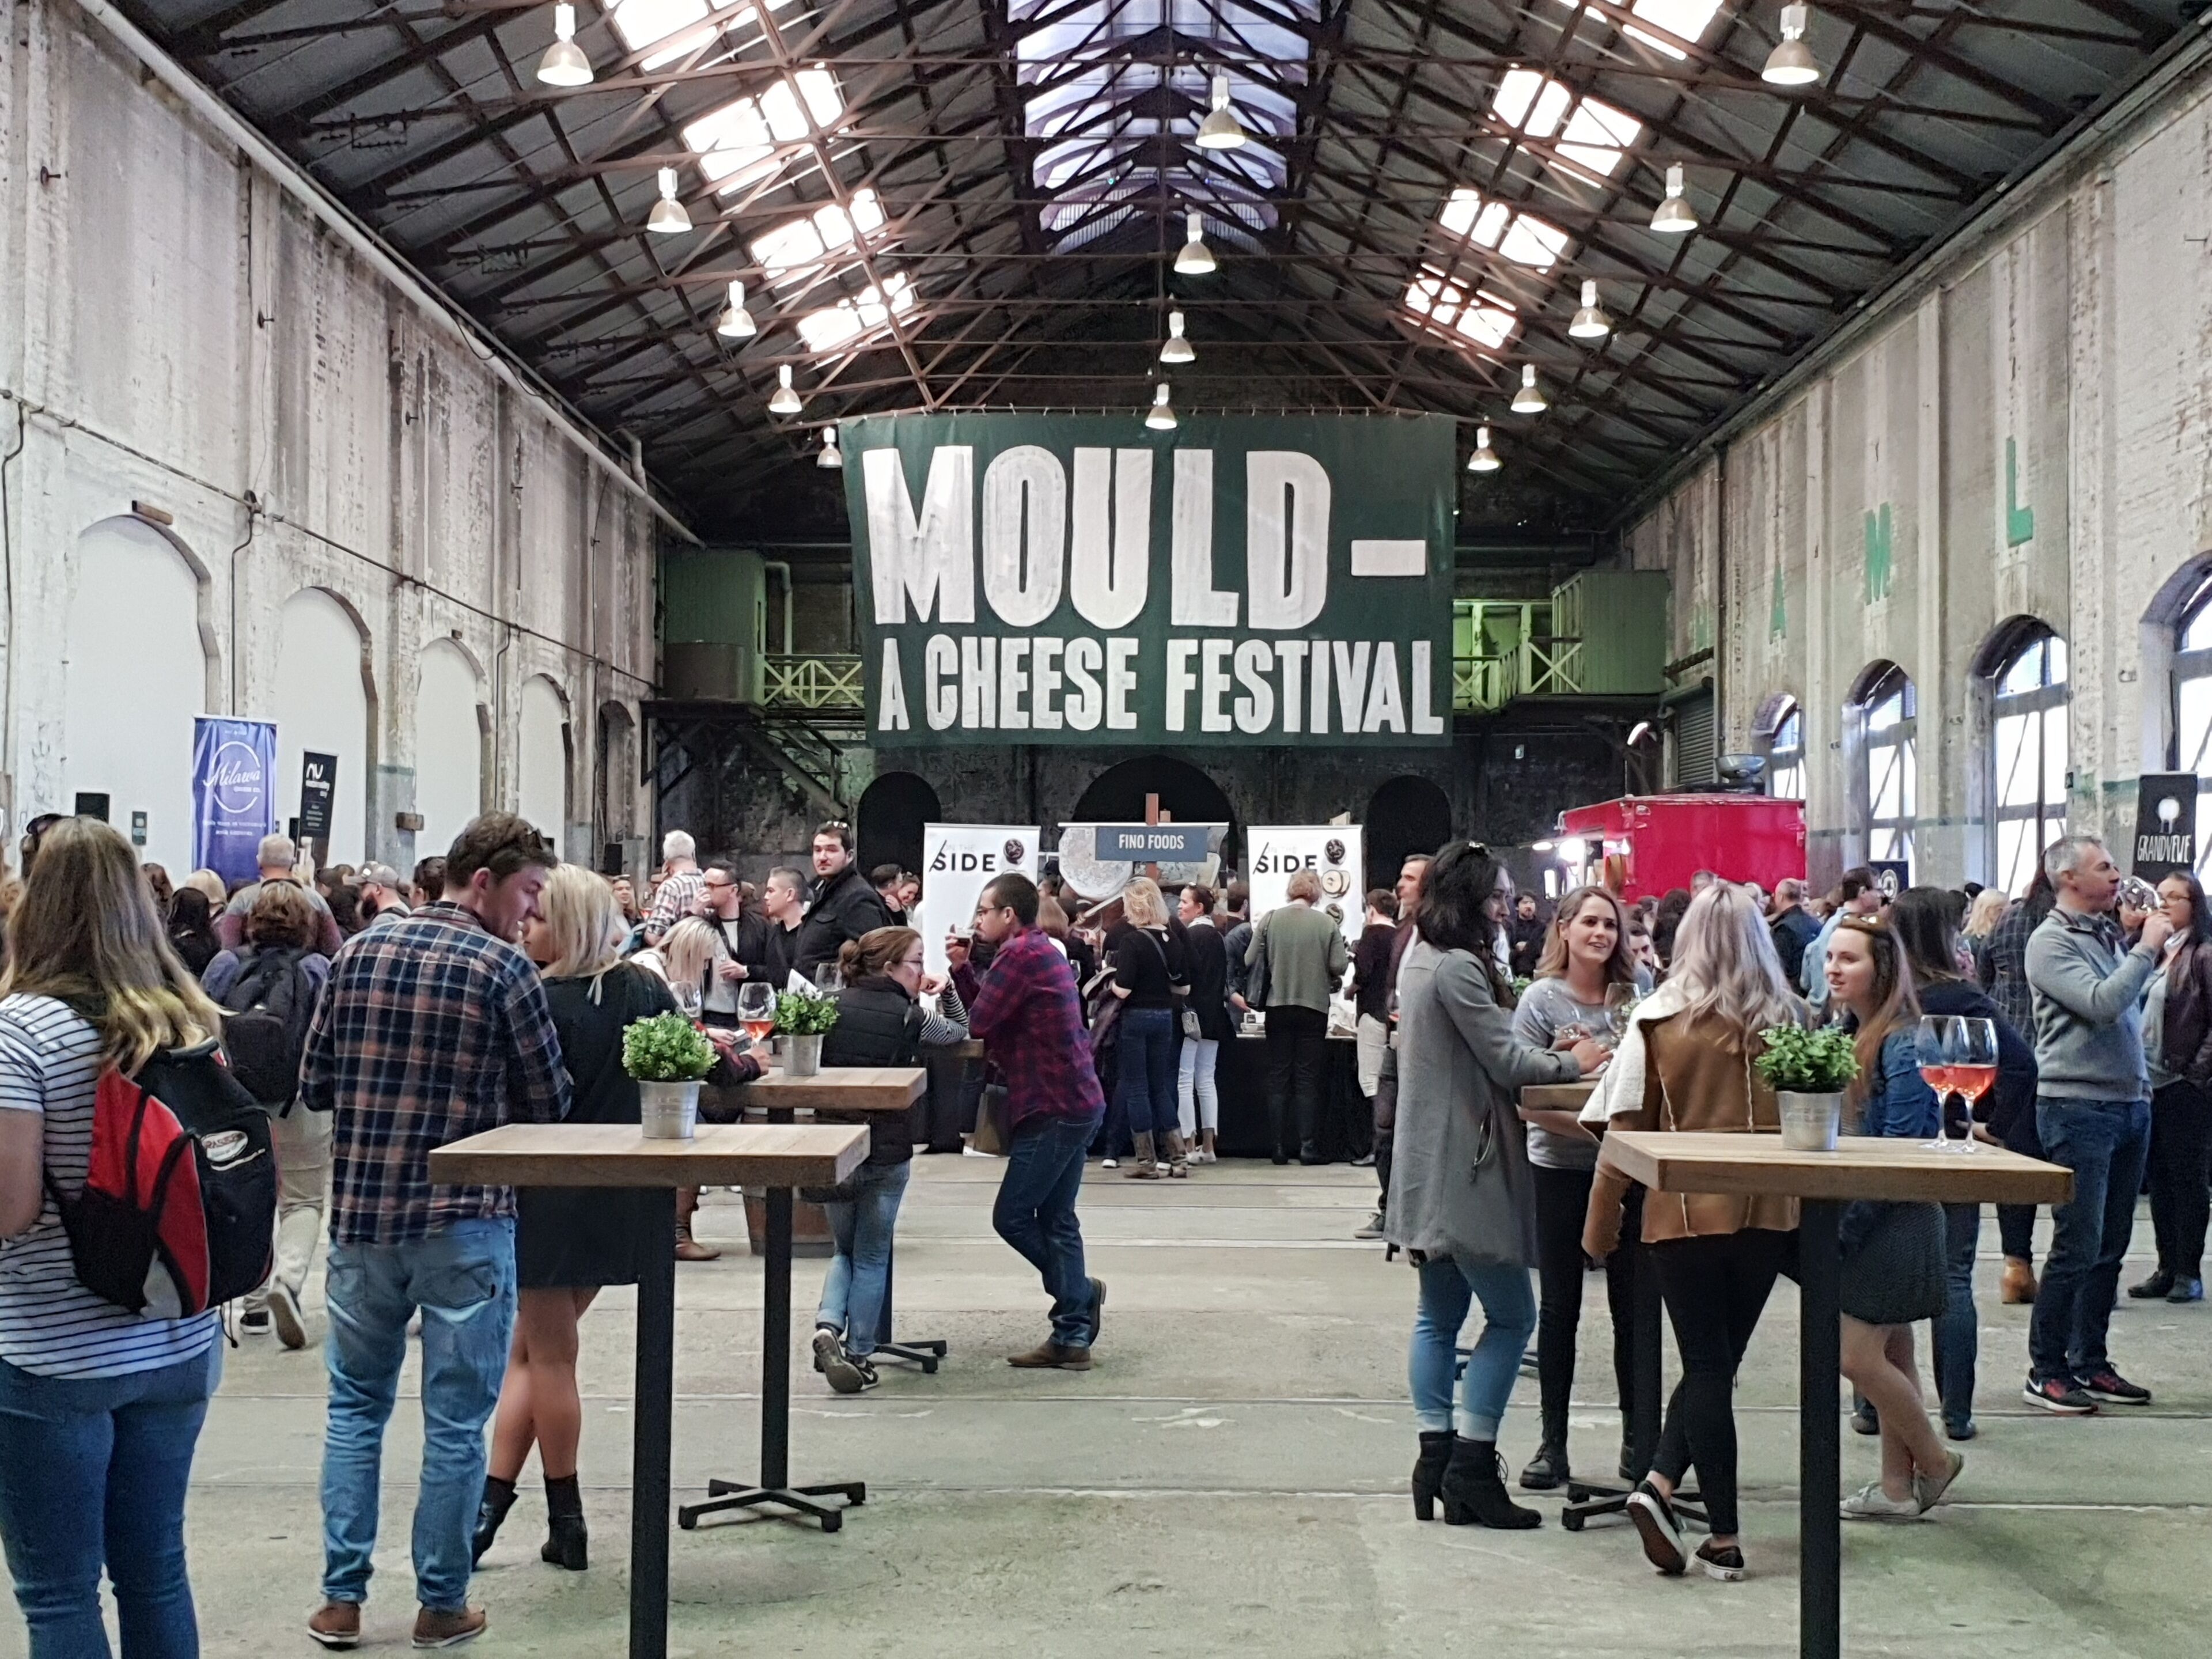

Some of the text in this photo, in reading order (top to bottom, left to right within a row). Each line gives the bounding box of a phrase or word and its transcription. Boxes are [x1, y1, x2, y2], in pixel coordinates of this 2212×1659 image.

[878, 634, 1444, 735] A CHEESE FESTIVAL
[202, 760, 260, 786] Milawa
[1119, 834, 1184, 849] FINO FOODS
[931, 853, 995, 872] SIDE
[1254, 855, 1317, 873] SIDE
